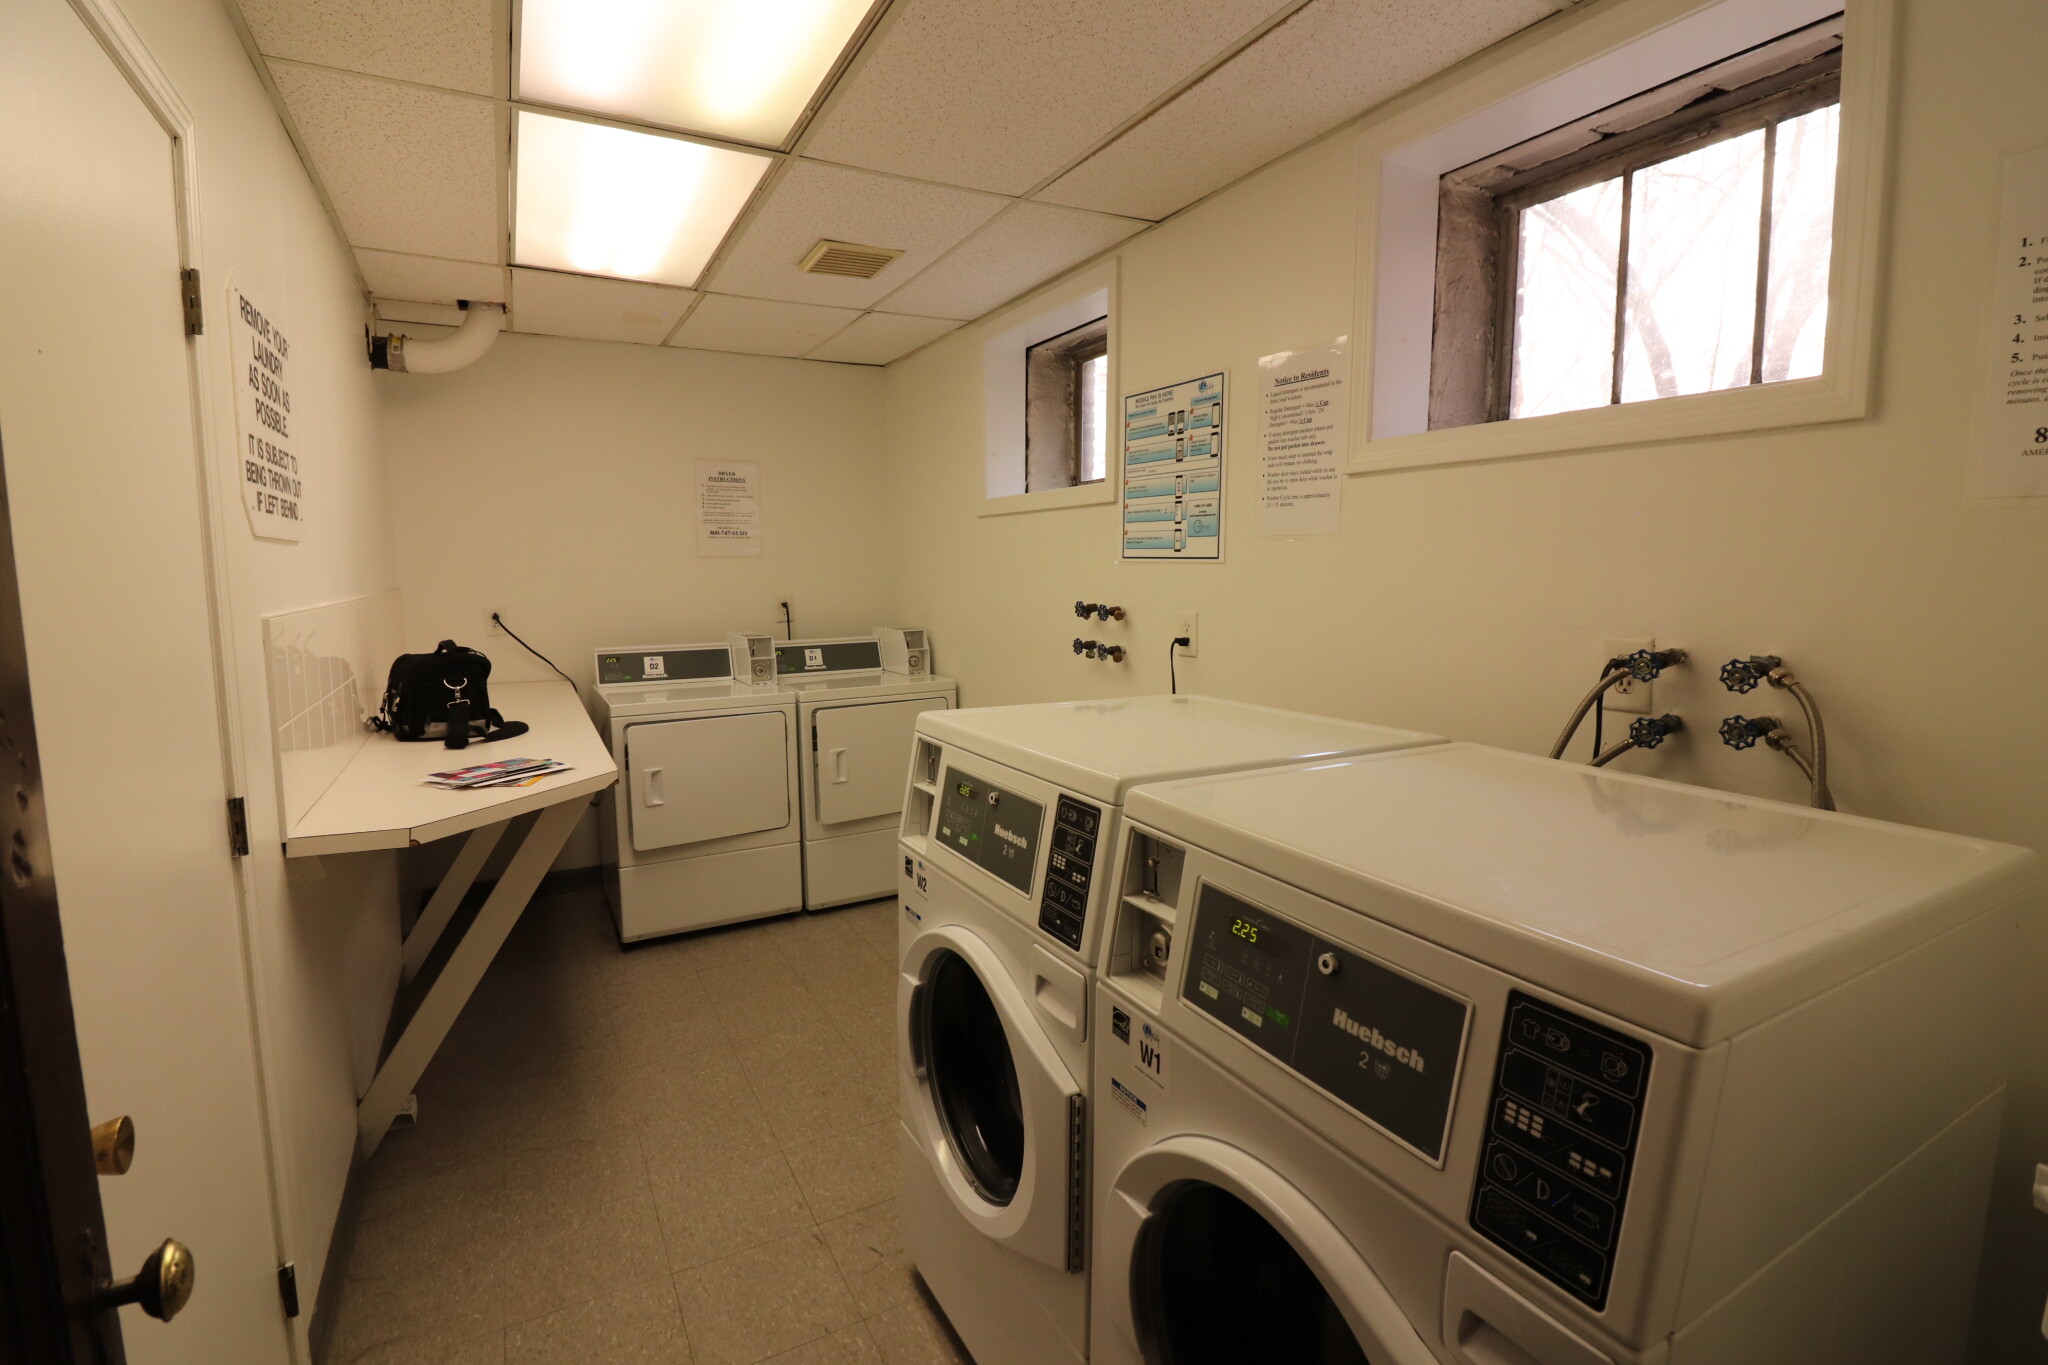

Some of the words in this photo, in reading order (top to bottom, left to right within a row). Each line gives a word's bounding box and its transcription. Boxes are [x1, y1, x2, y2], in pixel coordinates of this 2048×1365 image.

[2021, 237, 2033, 247] 1.
[2018, 257, 2031, 268] 2.
[239, 295, 270, 343] REMOVE
[272, 326, 288, 361] YOUR
[2014, 314, 2026, 325] 3.
[2012, 334, 2024, 344] 4.
[252, 336, 282, 381] LAUNDRY
[2011, 353, 2023, 363] 5.
[1274, 376, 1292, 386] Notice
[1294, 374, 1300, 382] to
[1300, 369, 1330, 380] Residents
[2008, 378, 2030, 387] cycle
[249, 364, 260, 391] AS
[261, 374, 280, 406] SOON
[282, 391, 290, 414] AS
[2007, 387, 2048, 396] removing
[1136, 395, 1149, 404] MOBILE
[1284, 404, 1301, 412] Detergent
[256, 398, 288, 438] POSSIBLE
[1279, 411, 1302, 419] Concentrated
[248, 434, 254, 456] IT
[256, 438, 264, 460] IS
[266, 442, 290, 471] SUBJECT
[290, 455, 298, 475] TO
[1288, 442, 1300, 450] packet
[246, 460, 266, 487] BEING
[268, 468, 292, 495] THROWN
[292, 478, 302, 498] OUT
[256, 491, 262, 512] IF
[264, 494, 278, 516] LEFT
[280, 498, 298, 520] BEHIND
[994, 824, 1028, 849] Huebsch
[1002, 844, 1008, 855] 2
[916, 872, 927, 893] W2
[1332, 1007, 1424, 1073] Huebsch
[1140, 1040, 1160, 1075] W1
[1358, 1050, 1369, 1070] 2
